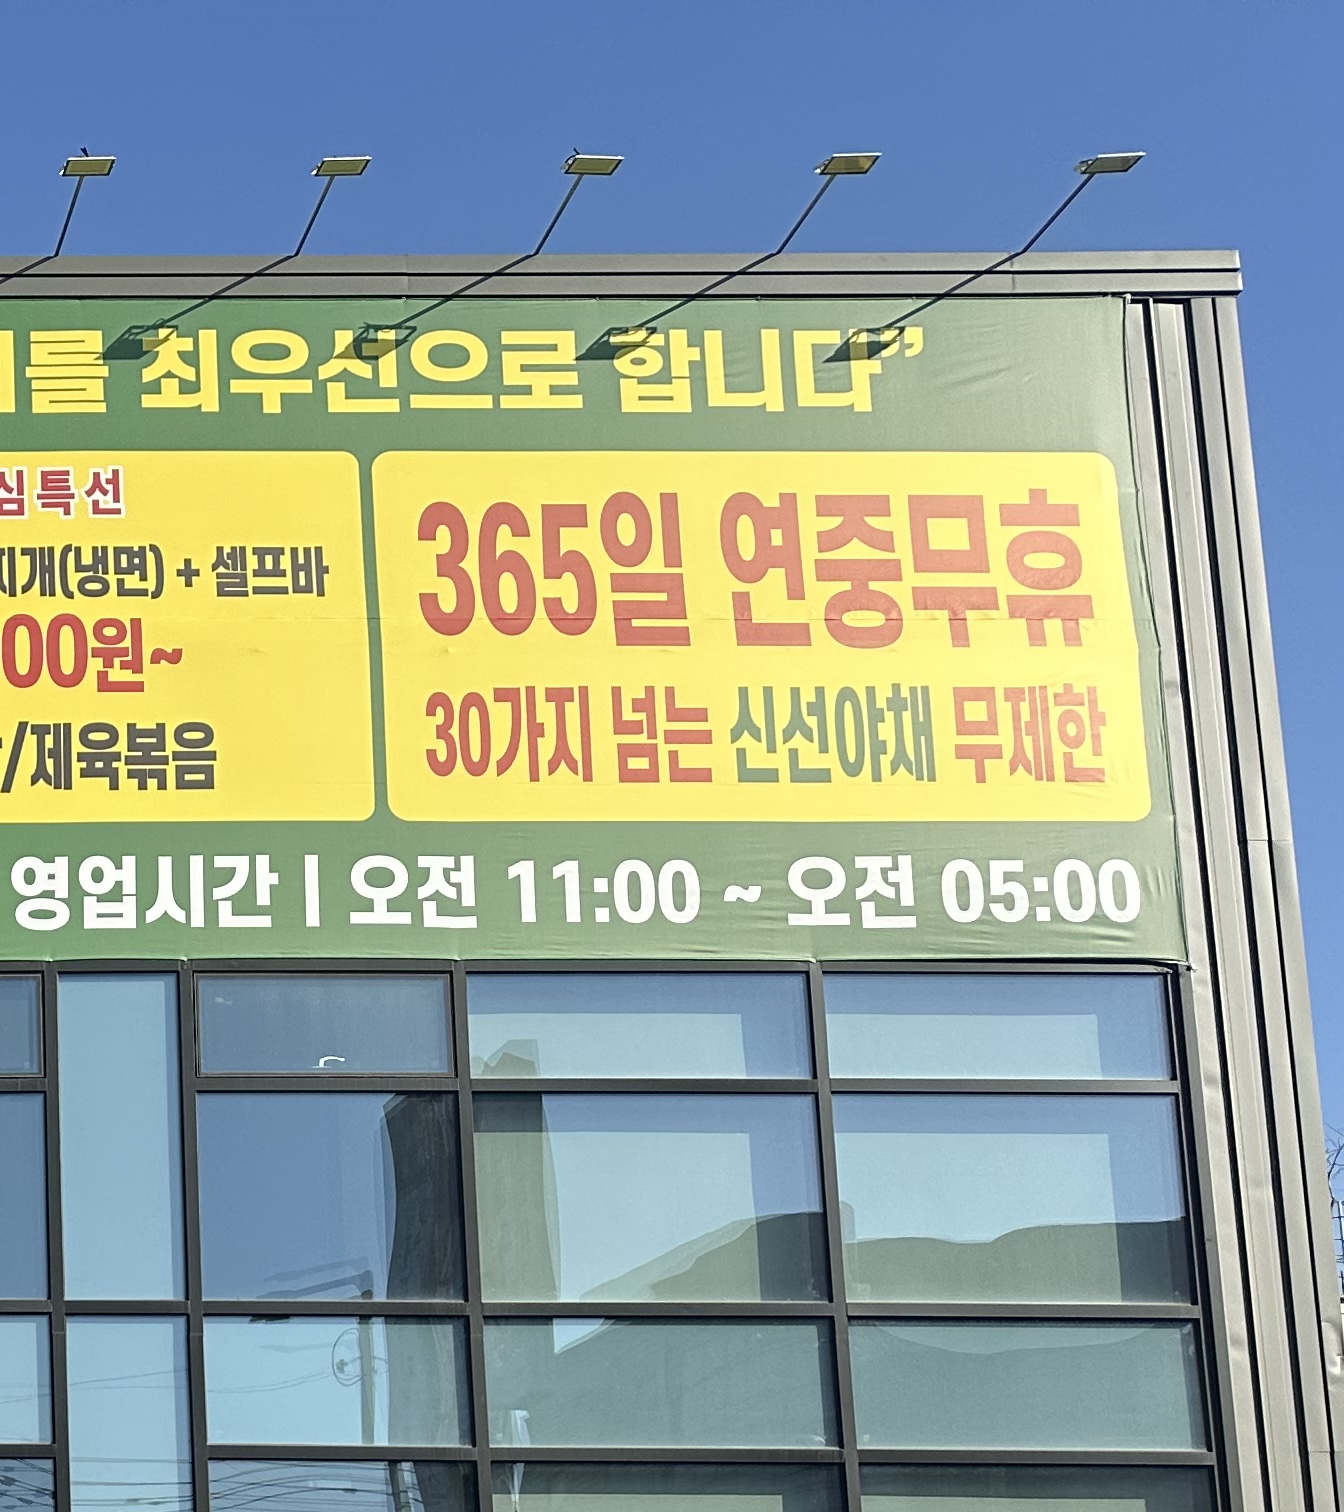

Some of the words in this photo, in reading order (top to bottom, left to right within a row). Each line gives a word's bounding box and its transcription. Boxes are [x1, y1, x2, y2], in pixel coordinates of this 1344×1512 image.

[141, 328, 584, 413] 최우선으로
[211, 545, 329, 598] 셀프바
[417, 490, 691, 647] 365일
[718, 487, 1095, 648] 연중무휴
[425, 685, 593, 783] 30가지
[611, 685, 713, 784] 넘는
[730, 683, 937, 783] 신선야채
[953, 682, 1107, 783] 무제한
[11, 854, 279, 931] 영업시간
[349, 854, 478, 928] 오전
[507, 858, 701, 925] 11:00
[787, 855, 917, 929] 오전
[941, 859, 1142, 923] 05:00
